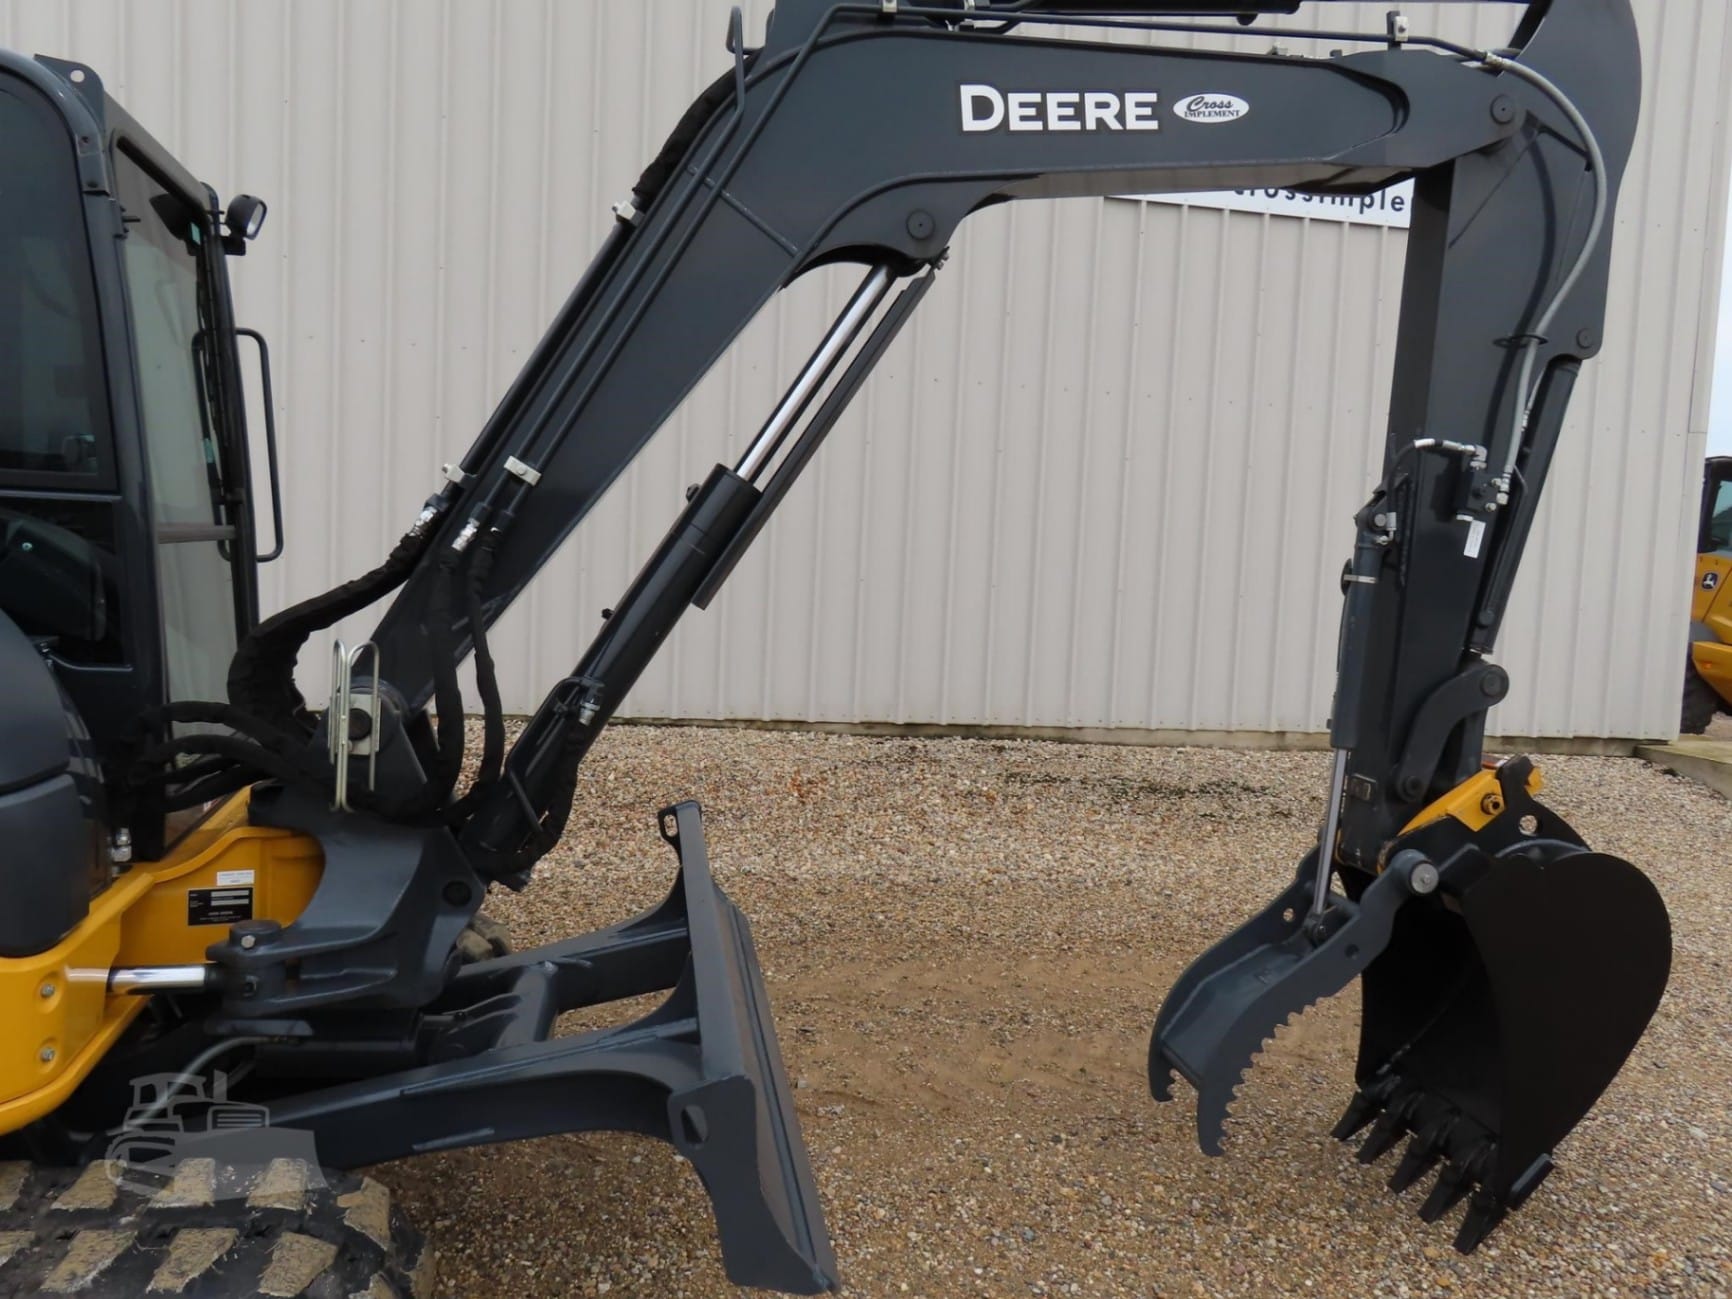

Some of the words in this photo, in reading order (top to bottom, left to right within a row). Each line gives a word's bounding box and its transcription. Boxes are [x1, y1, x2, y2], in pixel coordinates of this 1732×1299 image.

[960, 84, 1159, 131] DEERE
[1186, 96, 1233, 112] Cross
[1184, 109, 1241, 118] IMPLEMENT
